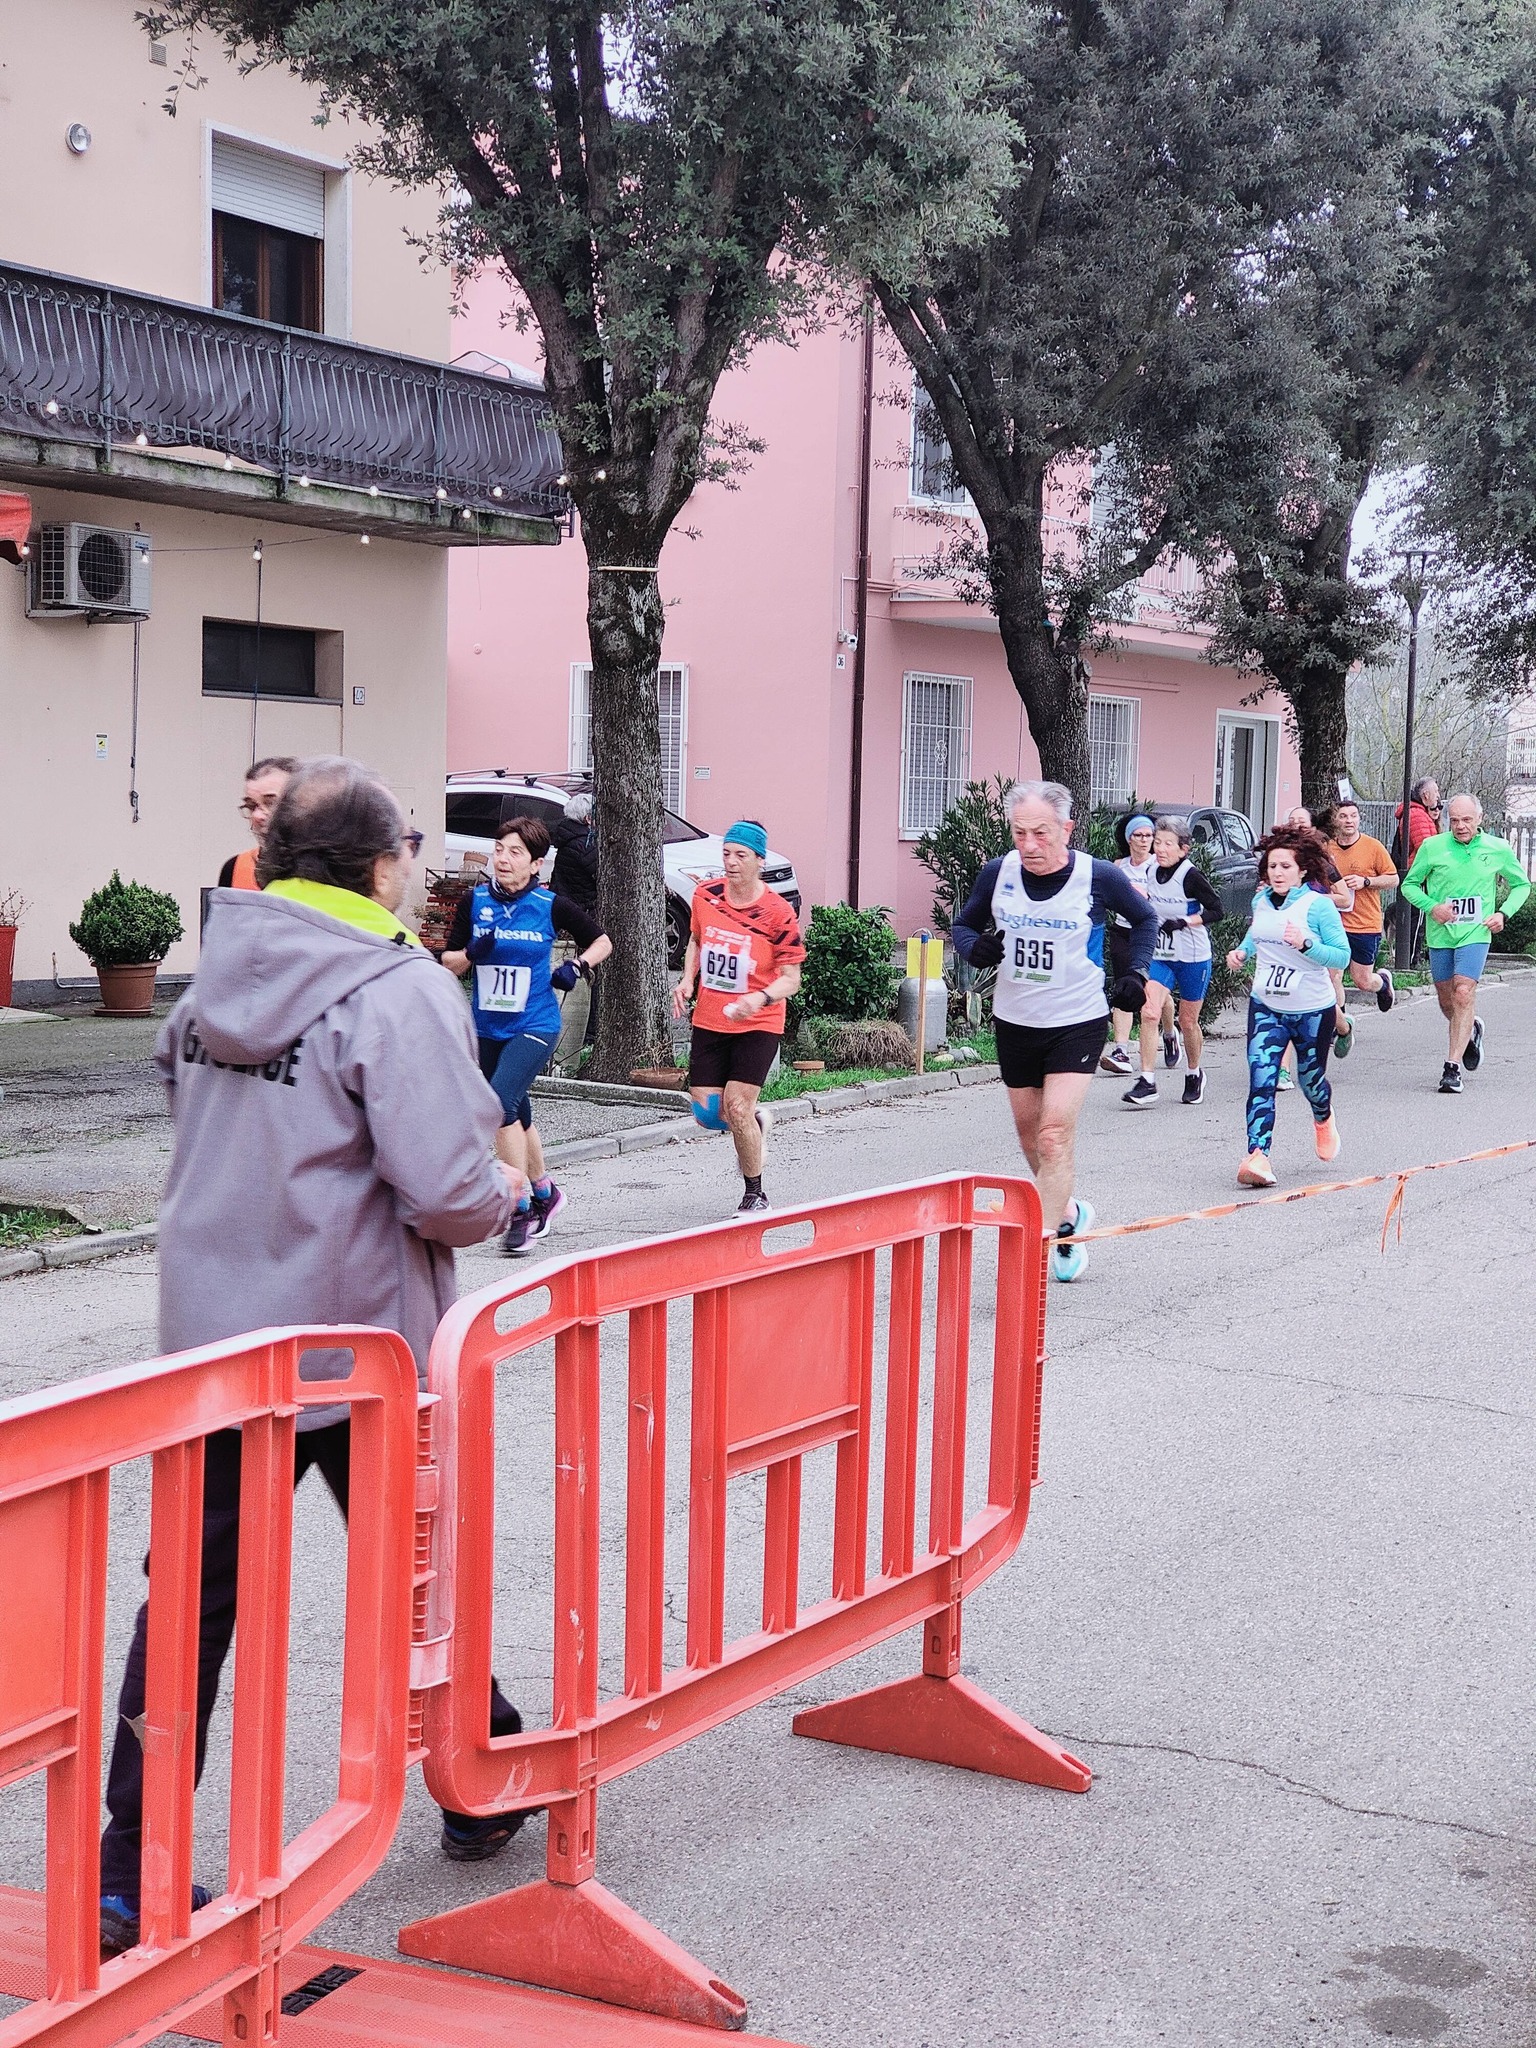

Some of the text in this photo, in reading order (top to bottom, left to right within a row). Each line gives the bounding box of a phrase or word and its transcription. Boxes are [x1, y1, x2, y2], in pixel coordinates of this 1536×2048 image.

[707, 950, 738, 980] 629
[1015, 937, 1054, 971] 635
[493, 967, 517, 996] 711
[1266, 964, 1296, 989] 787
